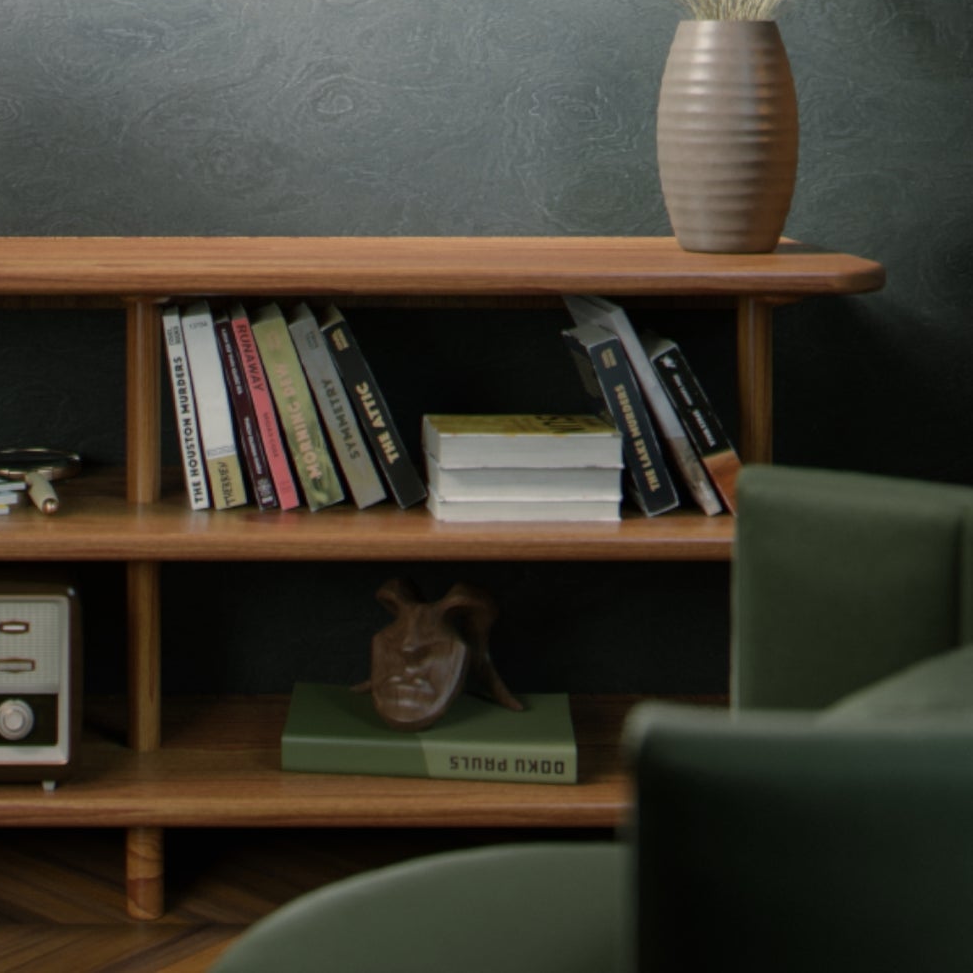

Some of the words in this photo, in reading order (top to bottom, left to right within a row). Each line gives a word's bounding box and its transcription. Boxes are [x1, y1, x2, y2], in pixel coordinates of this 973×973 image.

[174, 356, 191, 414] MURDERS
[238, 324, 265, 392] RUNAWAY
[322, 378, 361, 460] SYMMETRY
[355, 381, 385, 429] ATTIC
[614, 384, 641, 438] MURDERS
[182, 417, 200, 477] HOUSTON
[288, 401, 322, 480] MORNING
[377, 430, 400, 464] THE
[192, 481, 204, 503] THE
[645, 466, 661, 492] THE
[514, 759, 564, 774] DOKU
